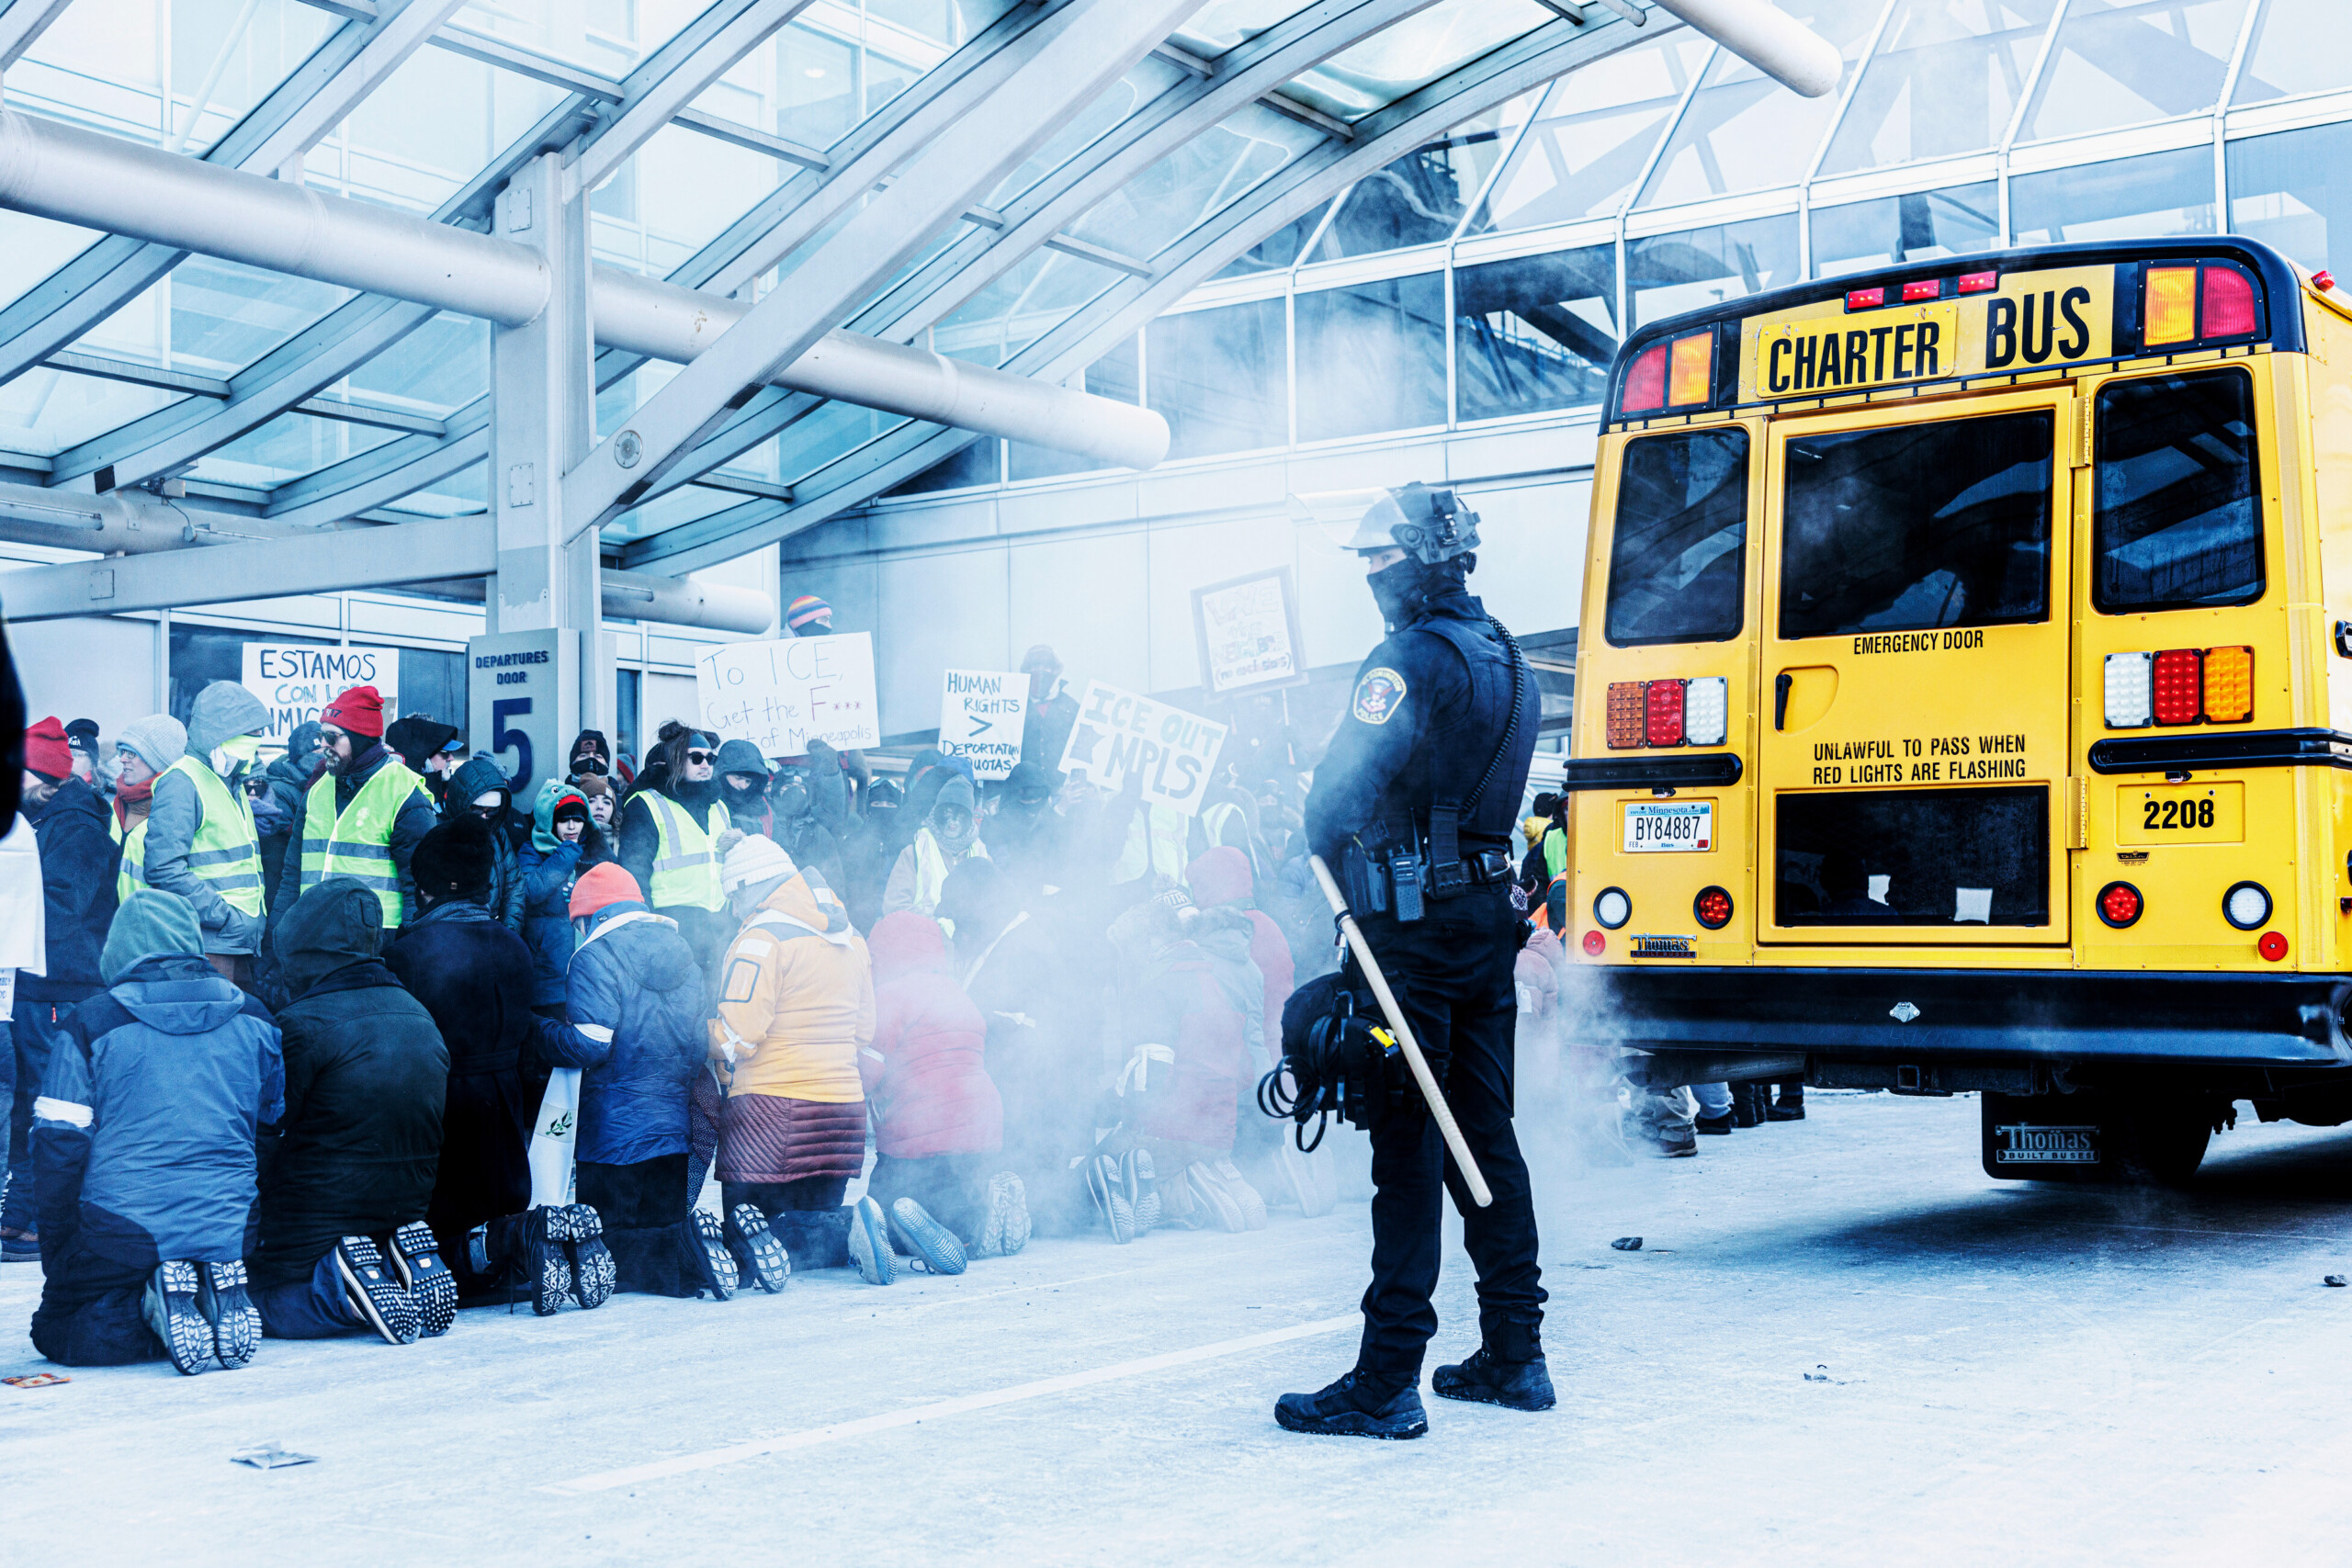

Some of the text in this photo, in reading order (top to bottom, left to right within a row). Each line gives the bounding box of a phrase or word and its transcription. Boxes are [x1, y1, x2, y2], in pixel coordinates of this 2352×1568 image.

[1769, 286, 2091, 393] CHARTER BUS
[1853, 630, 1984, 655] EMERGENCY DOOR
[260, 649, 376, 682] ESTAMOS
[476, 650, 548, 669] DEPARTURES
[702, 640, 843, 690] To ICE,
[496, 671, 526, 685] DOOR
[947, 671, 1001, 694] HUMAN
[275, 682, 360, 705] CON LO
[964, 697, 1020, 714] RIGHTS
[707, 701, 754, 729] Get
[763, 696, 799, 722] the
[1084, 687, 1224, 757] ICE OUT
[1358, 707, 1384, 721] POLICE
[492, 697, 533, 795] 5
[761, 727, 779, 750] of
[1814, 734, 2026, 761] UNLAWFUL TO PASS WHEN
[1103, 733, 1203, 800] MPLS
[1814, 759, 2026, 784] RED LIGHTS ARE FLASHING
[2143, 798, 2215, 829] 2208
[1636, 817, 1701, 840] BY84887
[1630, 932, 1697, 951] Thomas
[1996, 1122, 2099, 1150] Thomas
